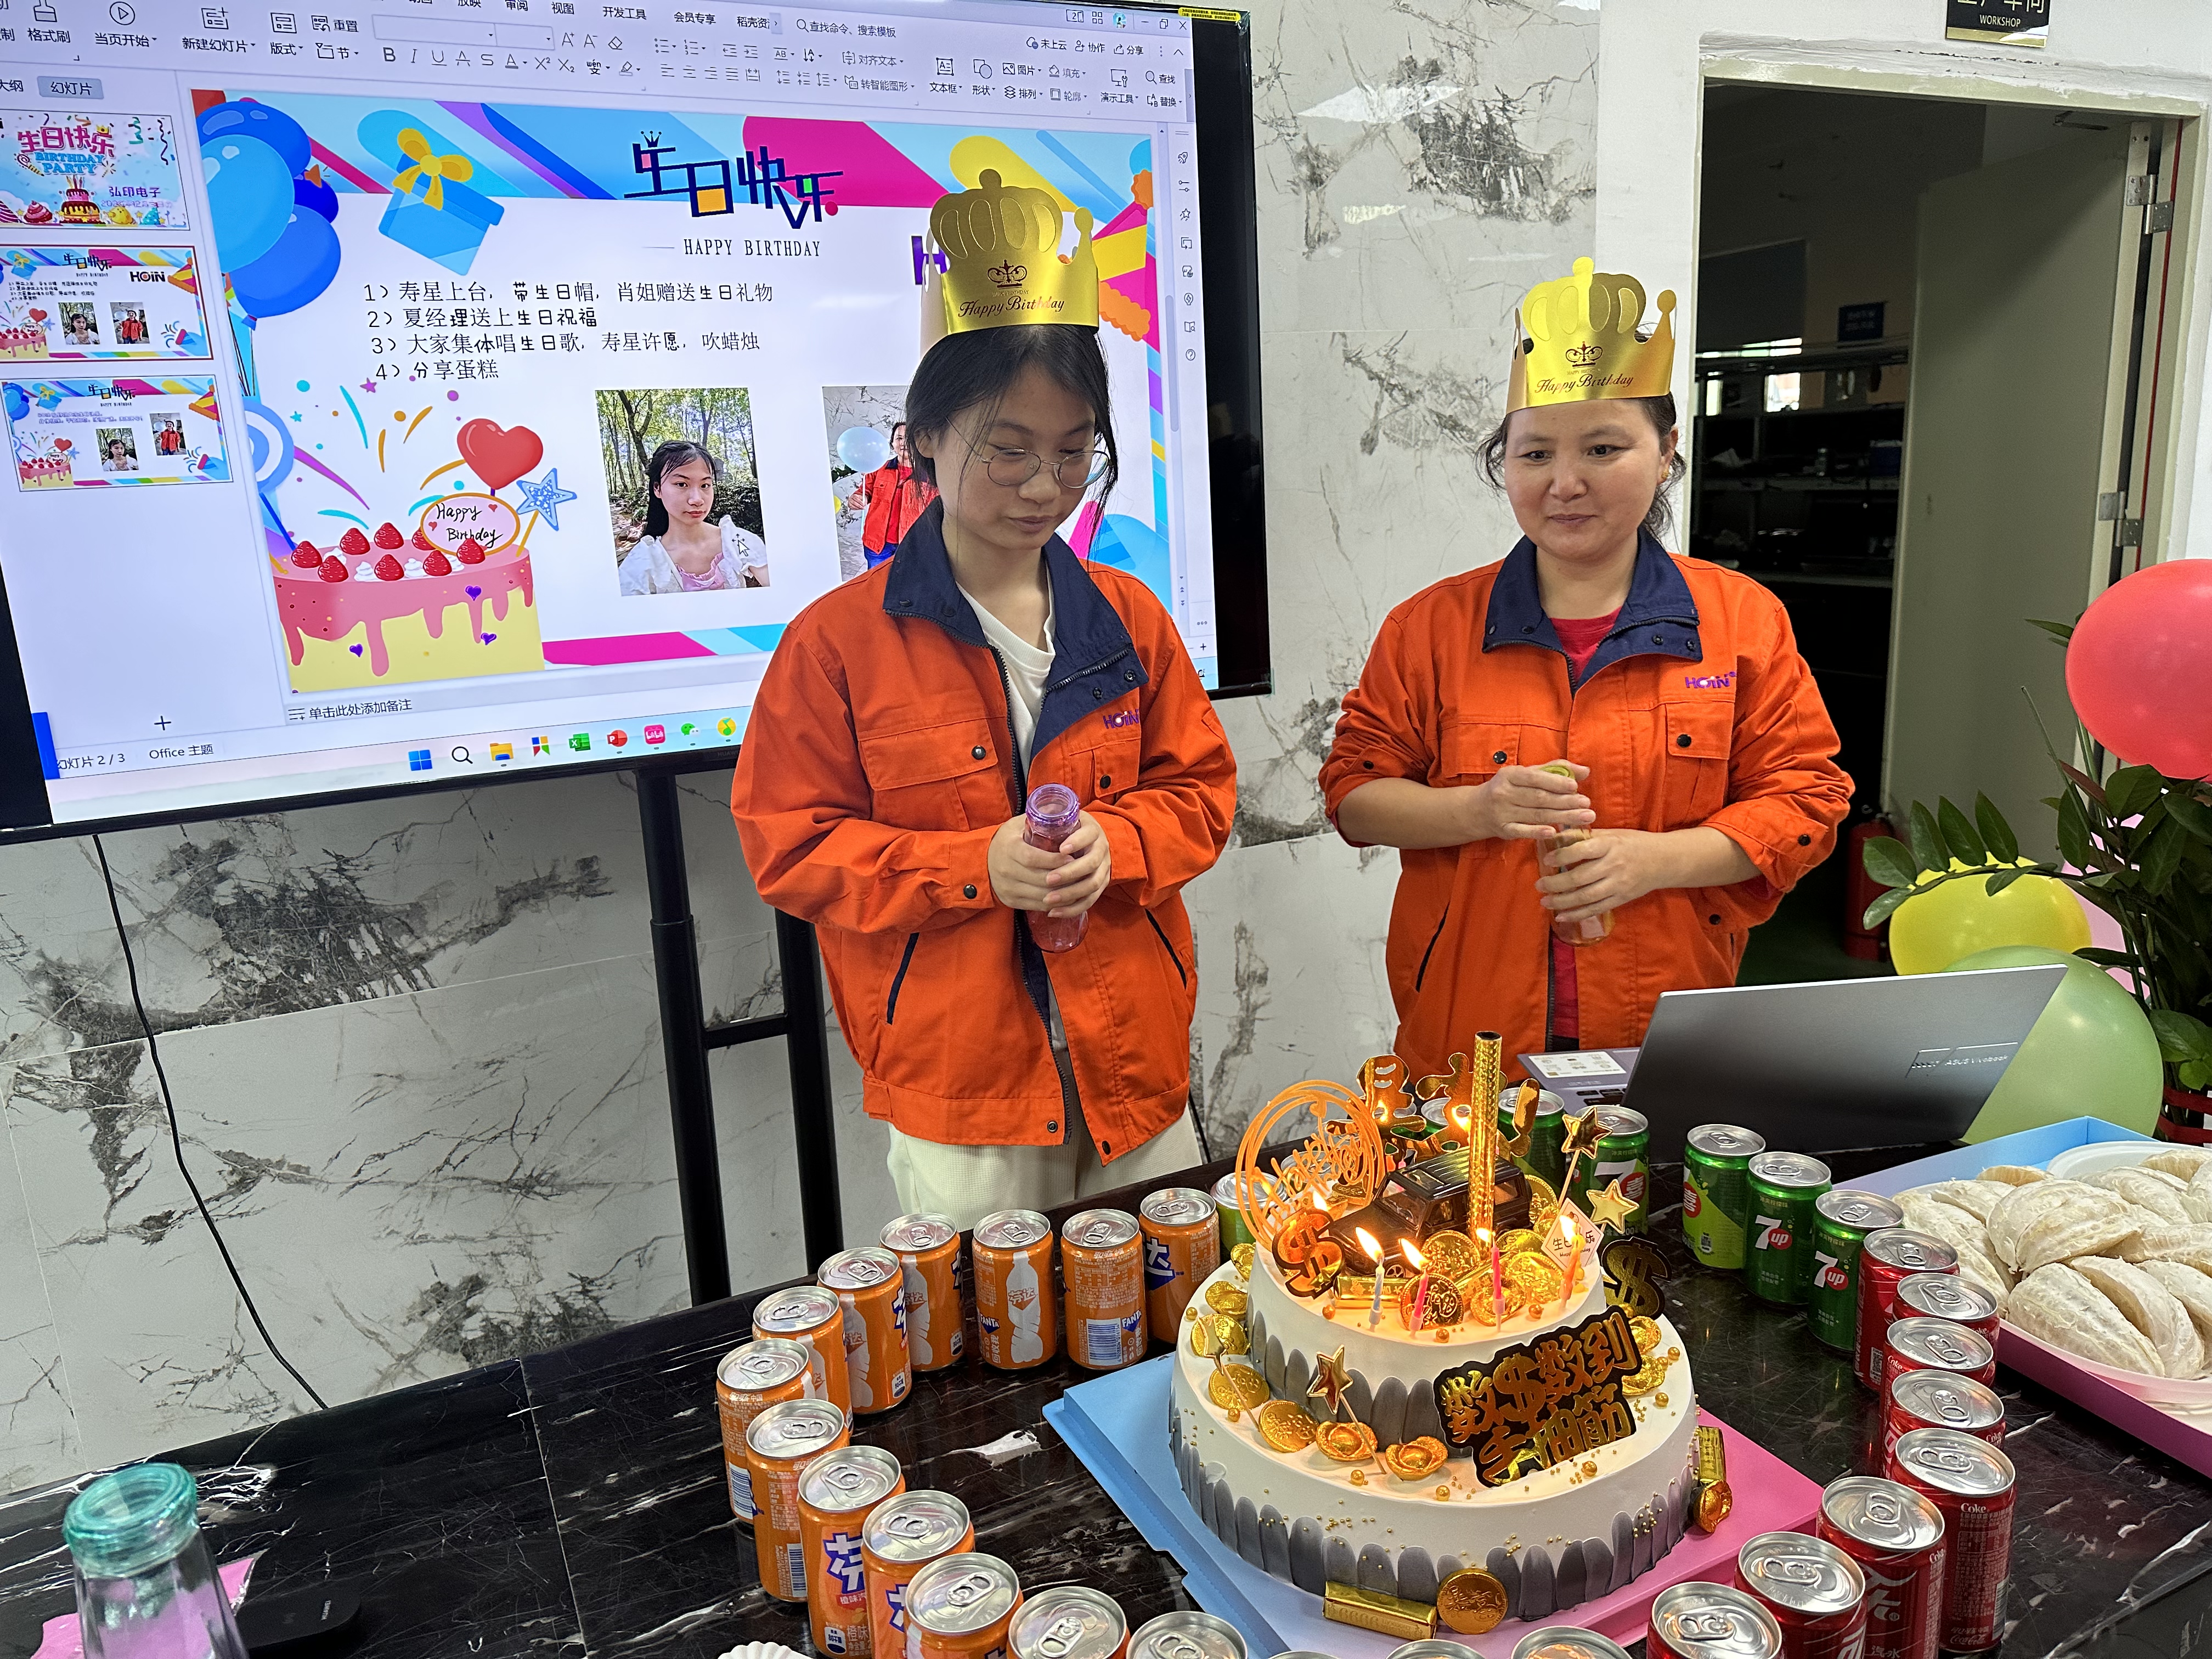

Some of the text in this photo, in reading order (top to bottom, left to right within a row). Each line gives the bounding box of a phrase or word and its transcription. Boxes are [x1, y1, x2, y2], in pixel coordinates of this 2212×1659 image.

[505, 0, 528, 11] 审阅
[551, 2, 574, 15] 视图
[603, 7, 647, 20] 开发工具
[674, 12, 716, 25] 会员专享
[333, 19, 359, 32] 重置
[1979, 14, 2021, 27] WORKSHOP
[0, 28, 15, 41] 制
[27, 28, 71, 43] 格式刷
[809, 21, 896, 38] 查找命令、搜索模板
[94, 32, 150, 48] 当页开始
[182, 37, 248, 53] 新建幻灯片
[1041, 38, 1067, 50] 未上云
[270, 42, 296, 55] 版式
[337, 47, 349, 59] 节
[1088, 42, 1105, 53] 协作
[1126, 45, 1144, 55] 分享
[859, 55, 897, 66] 对齐文本
[1018, 65, 1035, 76] 图片
[1062, 67, 1080, 78] 填充
[861, 78, 908, 92] 转智能图形
[1159, 74, 1176, 84] 查找
[50, 81, 92, 95] 幻灯片
[929, 82, 957, 94] 文本框
[972, 84, 990, 95] 形状
[1019, 88, 1036, 99] 排列
[1100, 92, 1134, 104] 演示工具
[18, 124, 115, 158] 生日快乐
[35, 151, 107, 165] BIRTHDAY
[43, 163, 97, 175] PARTY
[109, 186, 161, 198] 弘印电子
[624, 142, 844, 229] 生日快乐
[684, 239, 820, 257] HAPPY BIRTHDAY
[957, 295, 1065, 318] Happy Birthday
[1534, 373, 1634, 394] Happy Birthday
[436, 502, 483, 523] Happy
[445, 527, 504, 549] Birthday
[309, 698, 413, 720] 单击此处添加备注
[149, 743, 215, 760] Office 主题
[57, 756, 94, 770] 幻灯片
[98, 755, 106, 765] 2
[117, 753, 126, 763] 3
[1008, 1287, 1039, 1305] 芬达
[979, 1313, 1001, 1328] FANTA
[1122, 1309, 1142, 1327] FANTA
[1888, 1355, 1903, 1370] Coke
[751, 1393, 763, 1402] 中国
[1985, 1431, 2002, 1444] Coke
[1961, 1503, 1987, 1513] Coke
[1929, 1548, 1945, 1564] Coke
[1871, 1645, 1901, 1659] 汽水
